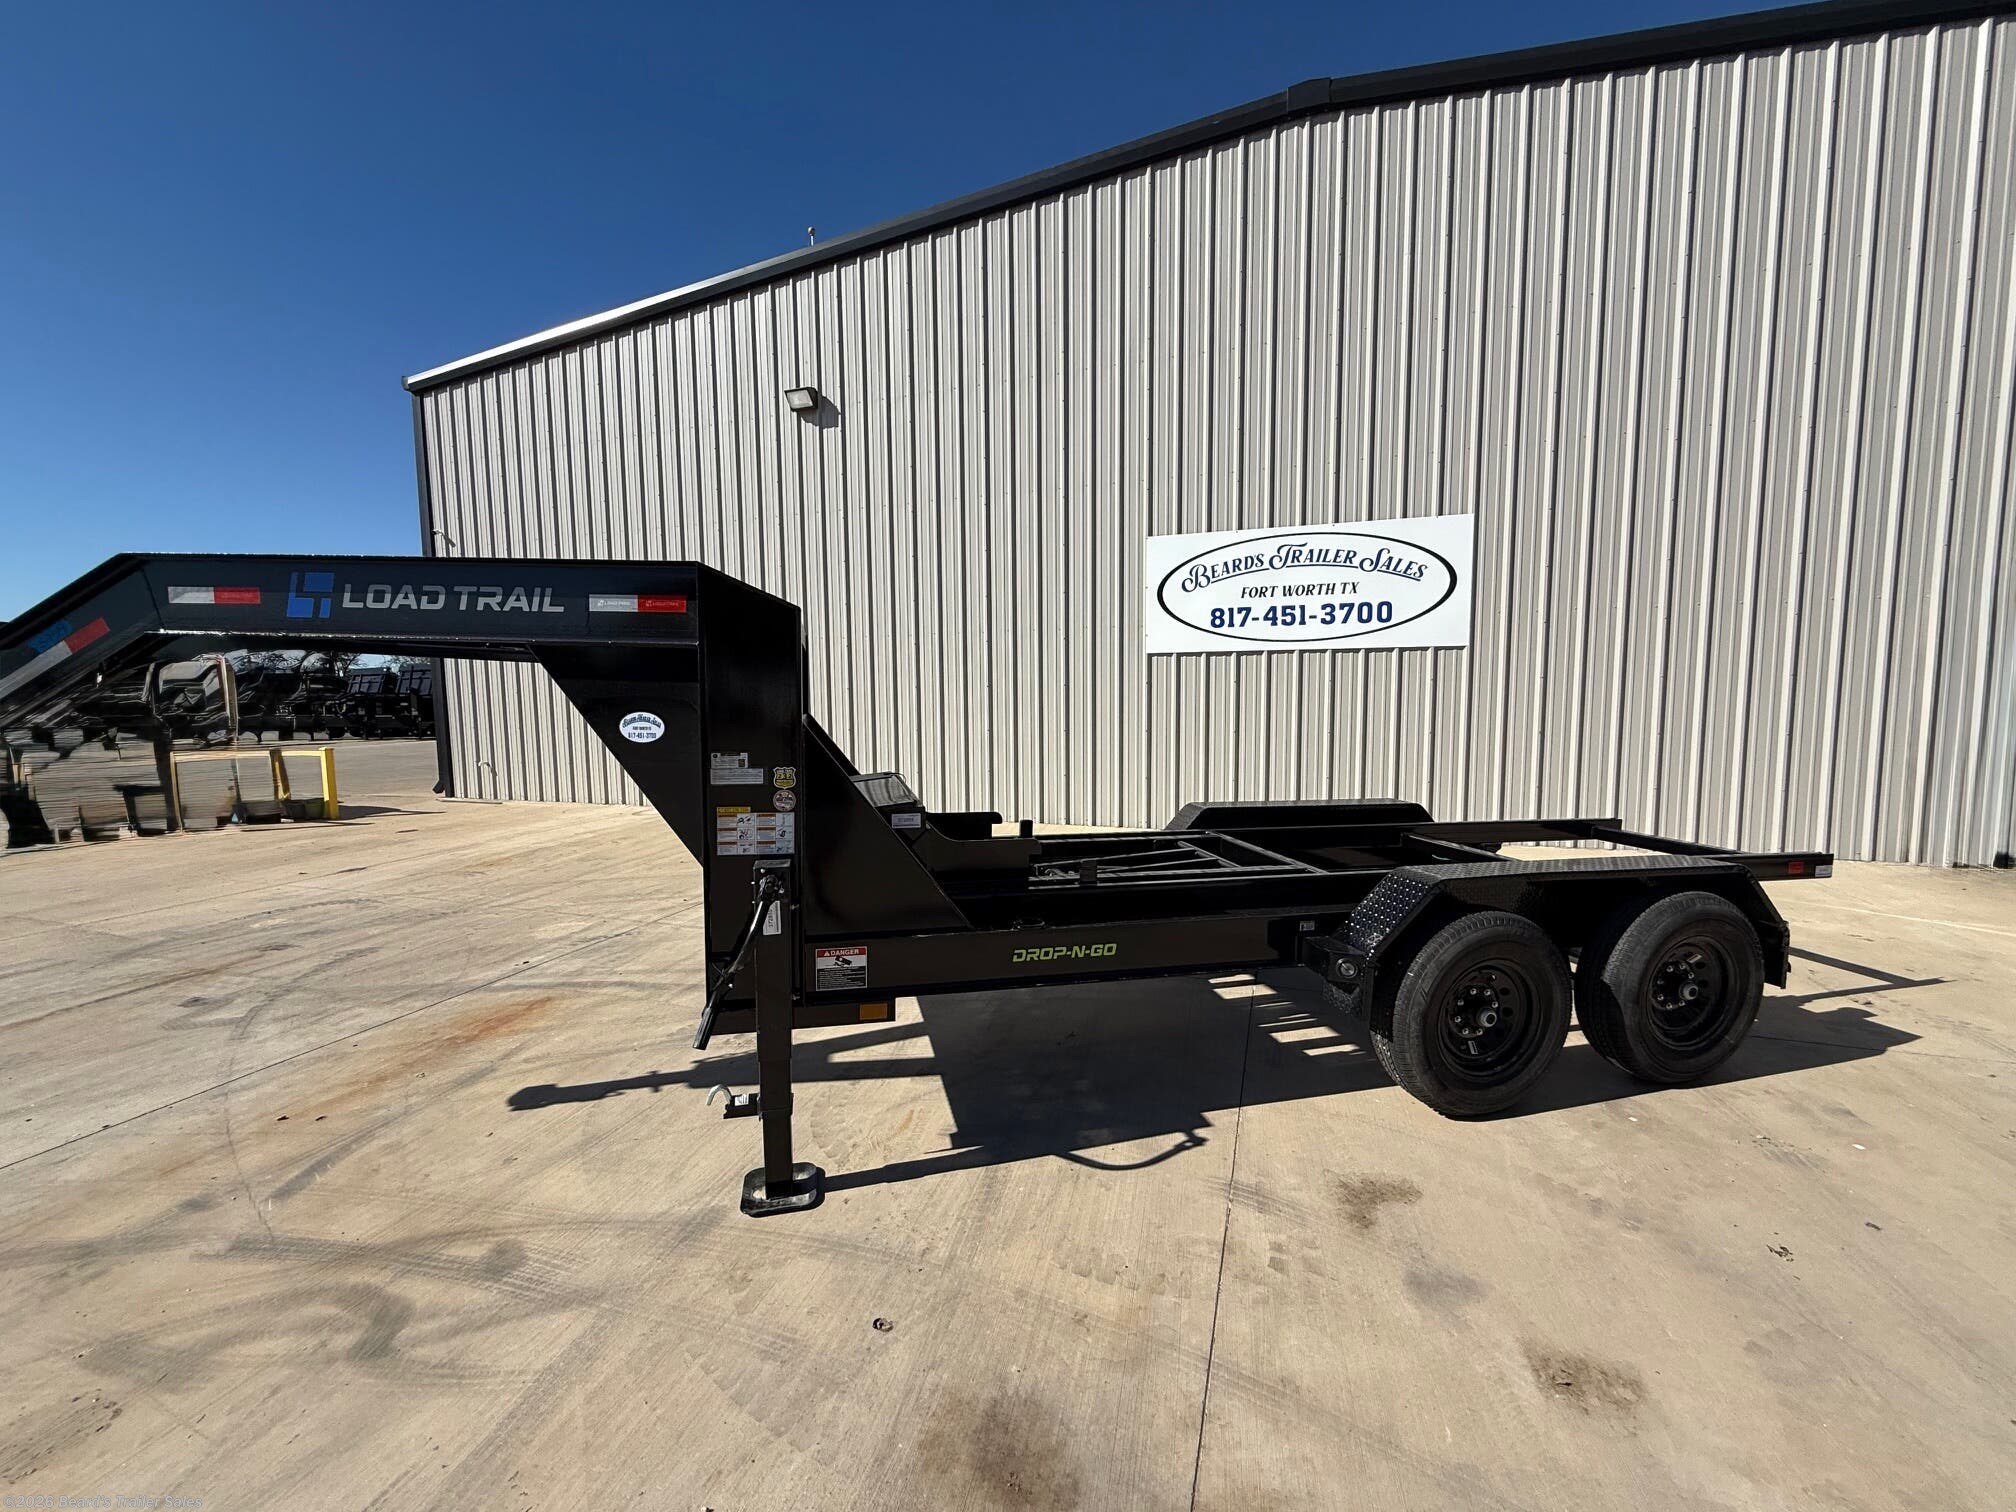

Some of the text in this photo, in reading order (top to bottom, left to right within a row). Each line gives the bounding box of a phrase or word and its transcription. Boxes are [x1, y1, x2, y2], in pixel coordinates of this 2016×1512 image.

[1268, 542, 1358, 570] TRAILER
[1358, 548, 1428, 579] SALES
[342, 584, 565, 613] LOAD TRAIL
[1240, 581, 1360, 599] FORT WORTH TX
[1210, 601, 1393, 629] 817-451-3700
[1012, 943, 1117, 962] DROP-N-GO
